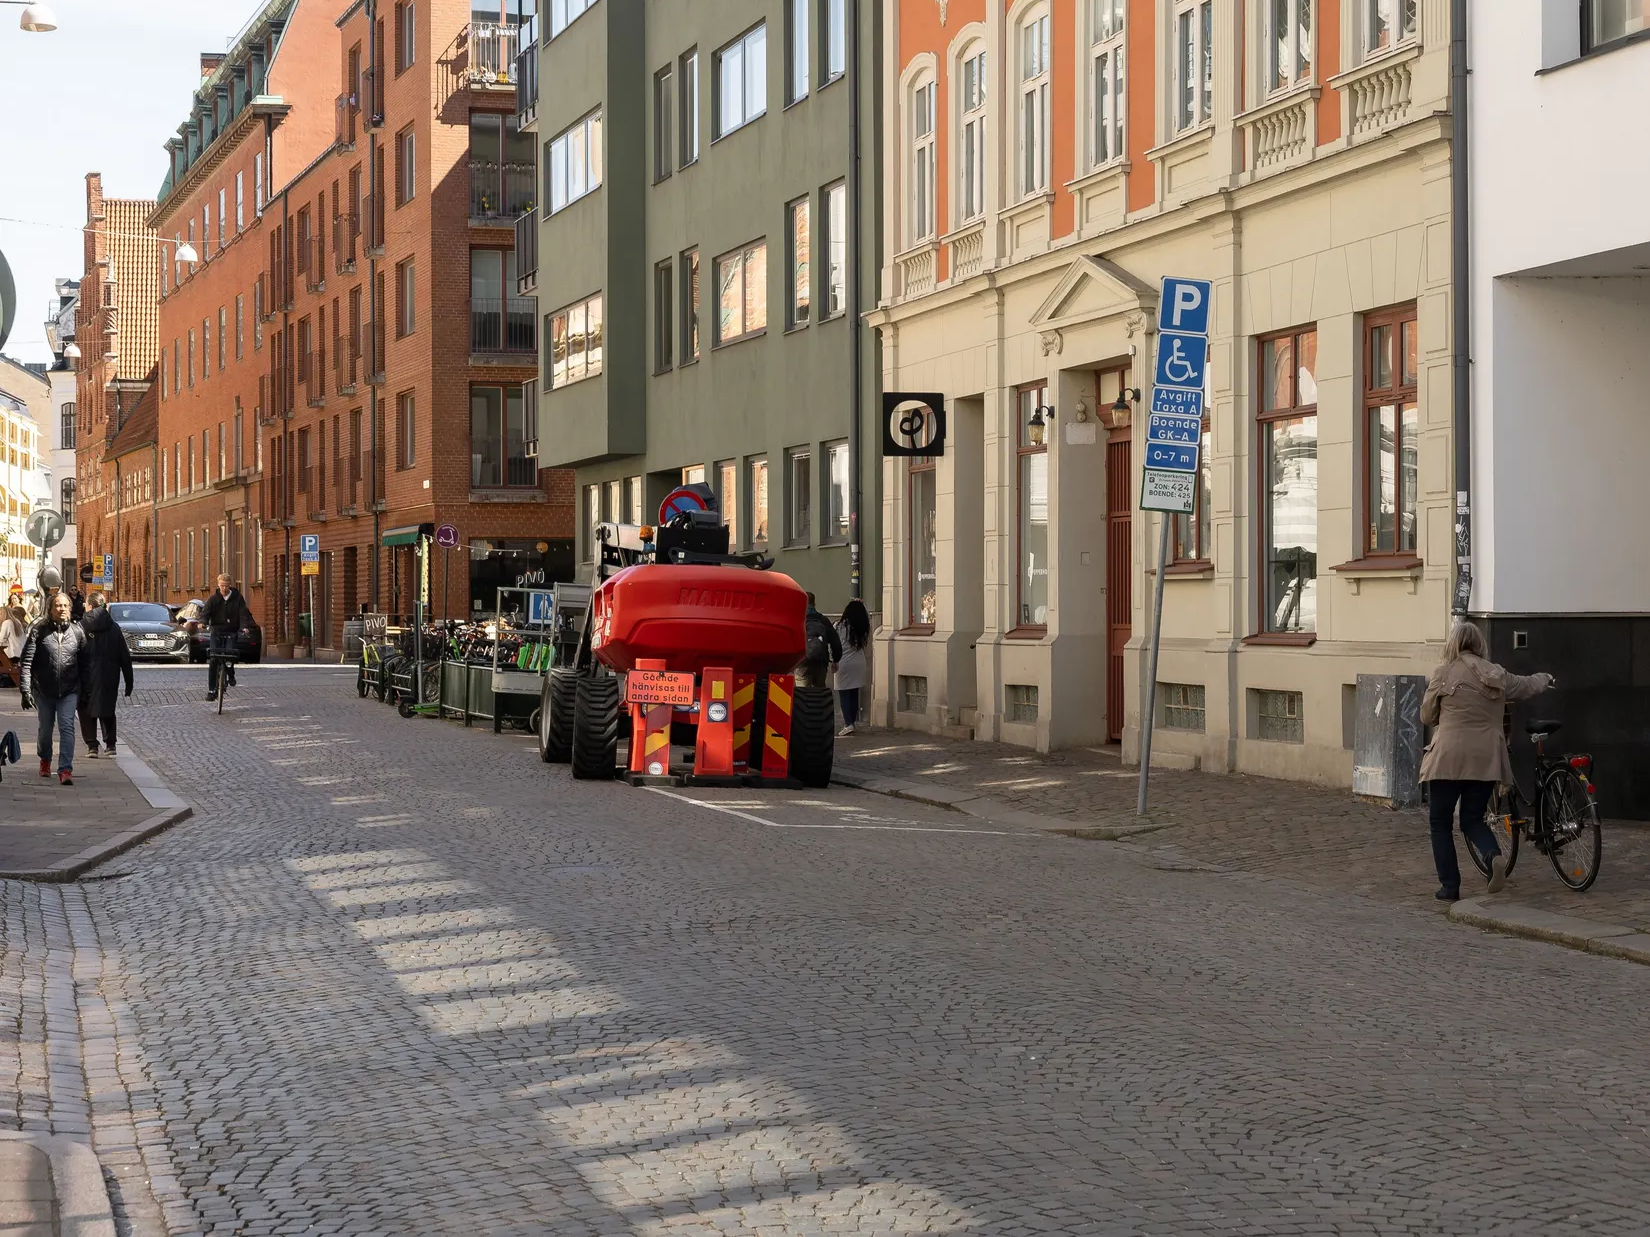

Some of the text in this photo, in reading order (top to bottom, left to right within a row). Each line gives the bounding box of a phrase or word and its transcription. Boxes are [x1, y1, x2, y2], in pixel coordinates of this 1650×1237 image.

[1172, 283, 1202, 326] P
[1159, 390, 1196, 403] Avgift
[1156, 401, 1197, 414] Taxa A
[1152, 416, 1198, 429] Boende
[1158, 429, 1189, 441] GK-A
[1180, 455, 1190, 463] m
[1171, 483, 1190, 492] 424
[1149, 490, 1176, 498] BOENDE:
[305, 536, 316, 551] P
[105, 554, 112, 564] P
[365, 616, 386, 631] PIVO
[642, 672, 679, 682] Gående
[632, 682, 690, 693] hänvisas till
[631, 693, 689, 702] andra sidan
